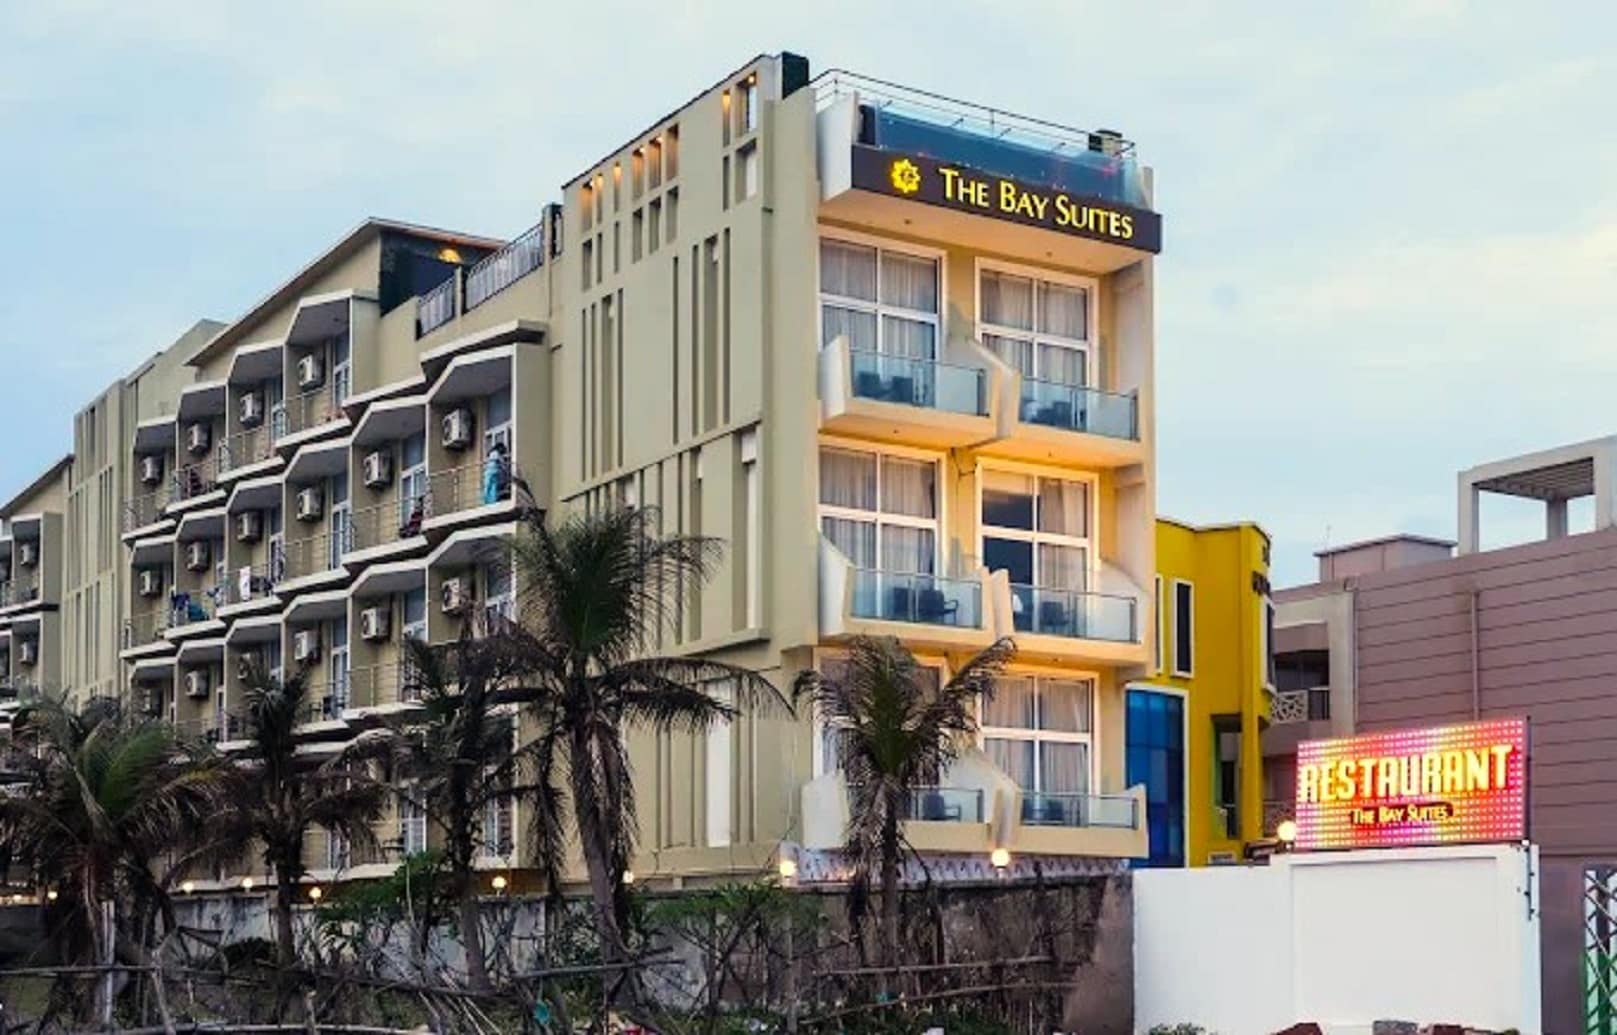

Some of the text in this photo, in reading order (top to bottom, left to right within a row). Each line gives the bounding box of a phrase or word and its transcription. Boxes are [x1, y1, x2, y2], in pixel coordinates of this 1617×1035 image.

[939, 168, 1133, 239] THE BAY SUITES
[1298, 745, 1513, 803] RESTAURANT
[1352, 804, 1449, 824] THE BAY SUITES
